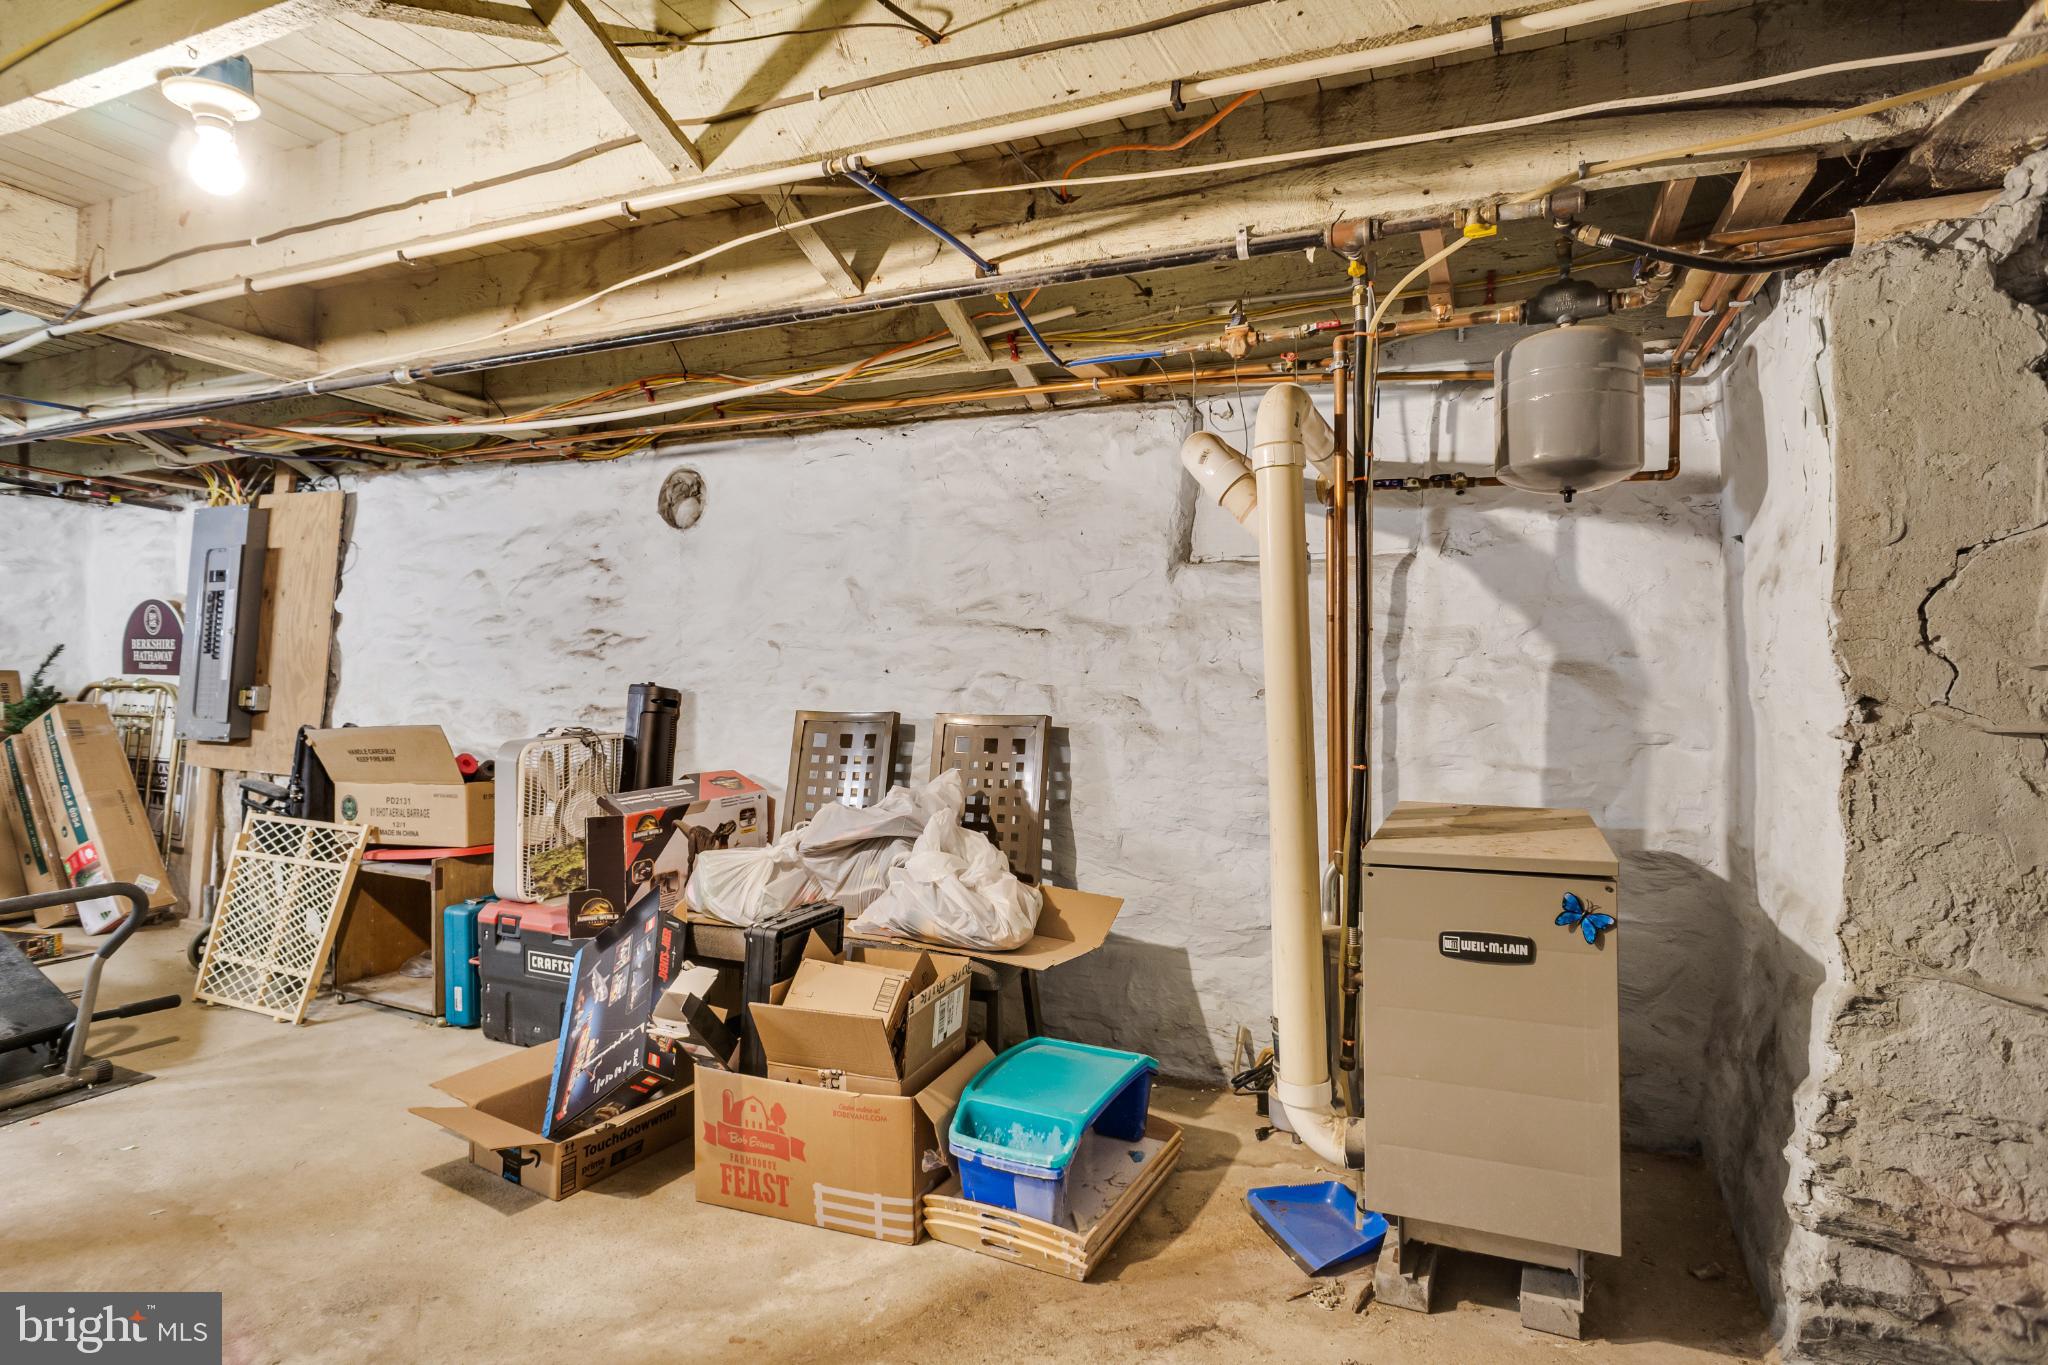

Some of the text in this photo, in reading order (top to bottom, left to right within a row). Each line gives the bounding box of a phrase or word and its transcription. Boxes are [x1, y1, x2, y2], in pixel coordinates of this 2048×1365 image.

[131, 638, 176, 650] BERKSHIRE
[133, 650, 174, 662] HATHAWAY
[385, 796, 412, 805] PD2131
[406, 808, 431, 818] BARRAGE
[832, 1110, 888, 1122] BOBEVANS.COM
[728, 1131, 776, 1150] Bob Evans
[720, 1163, 790, 1208] FEAST
